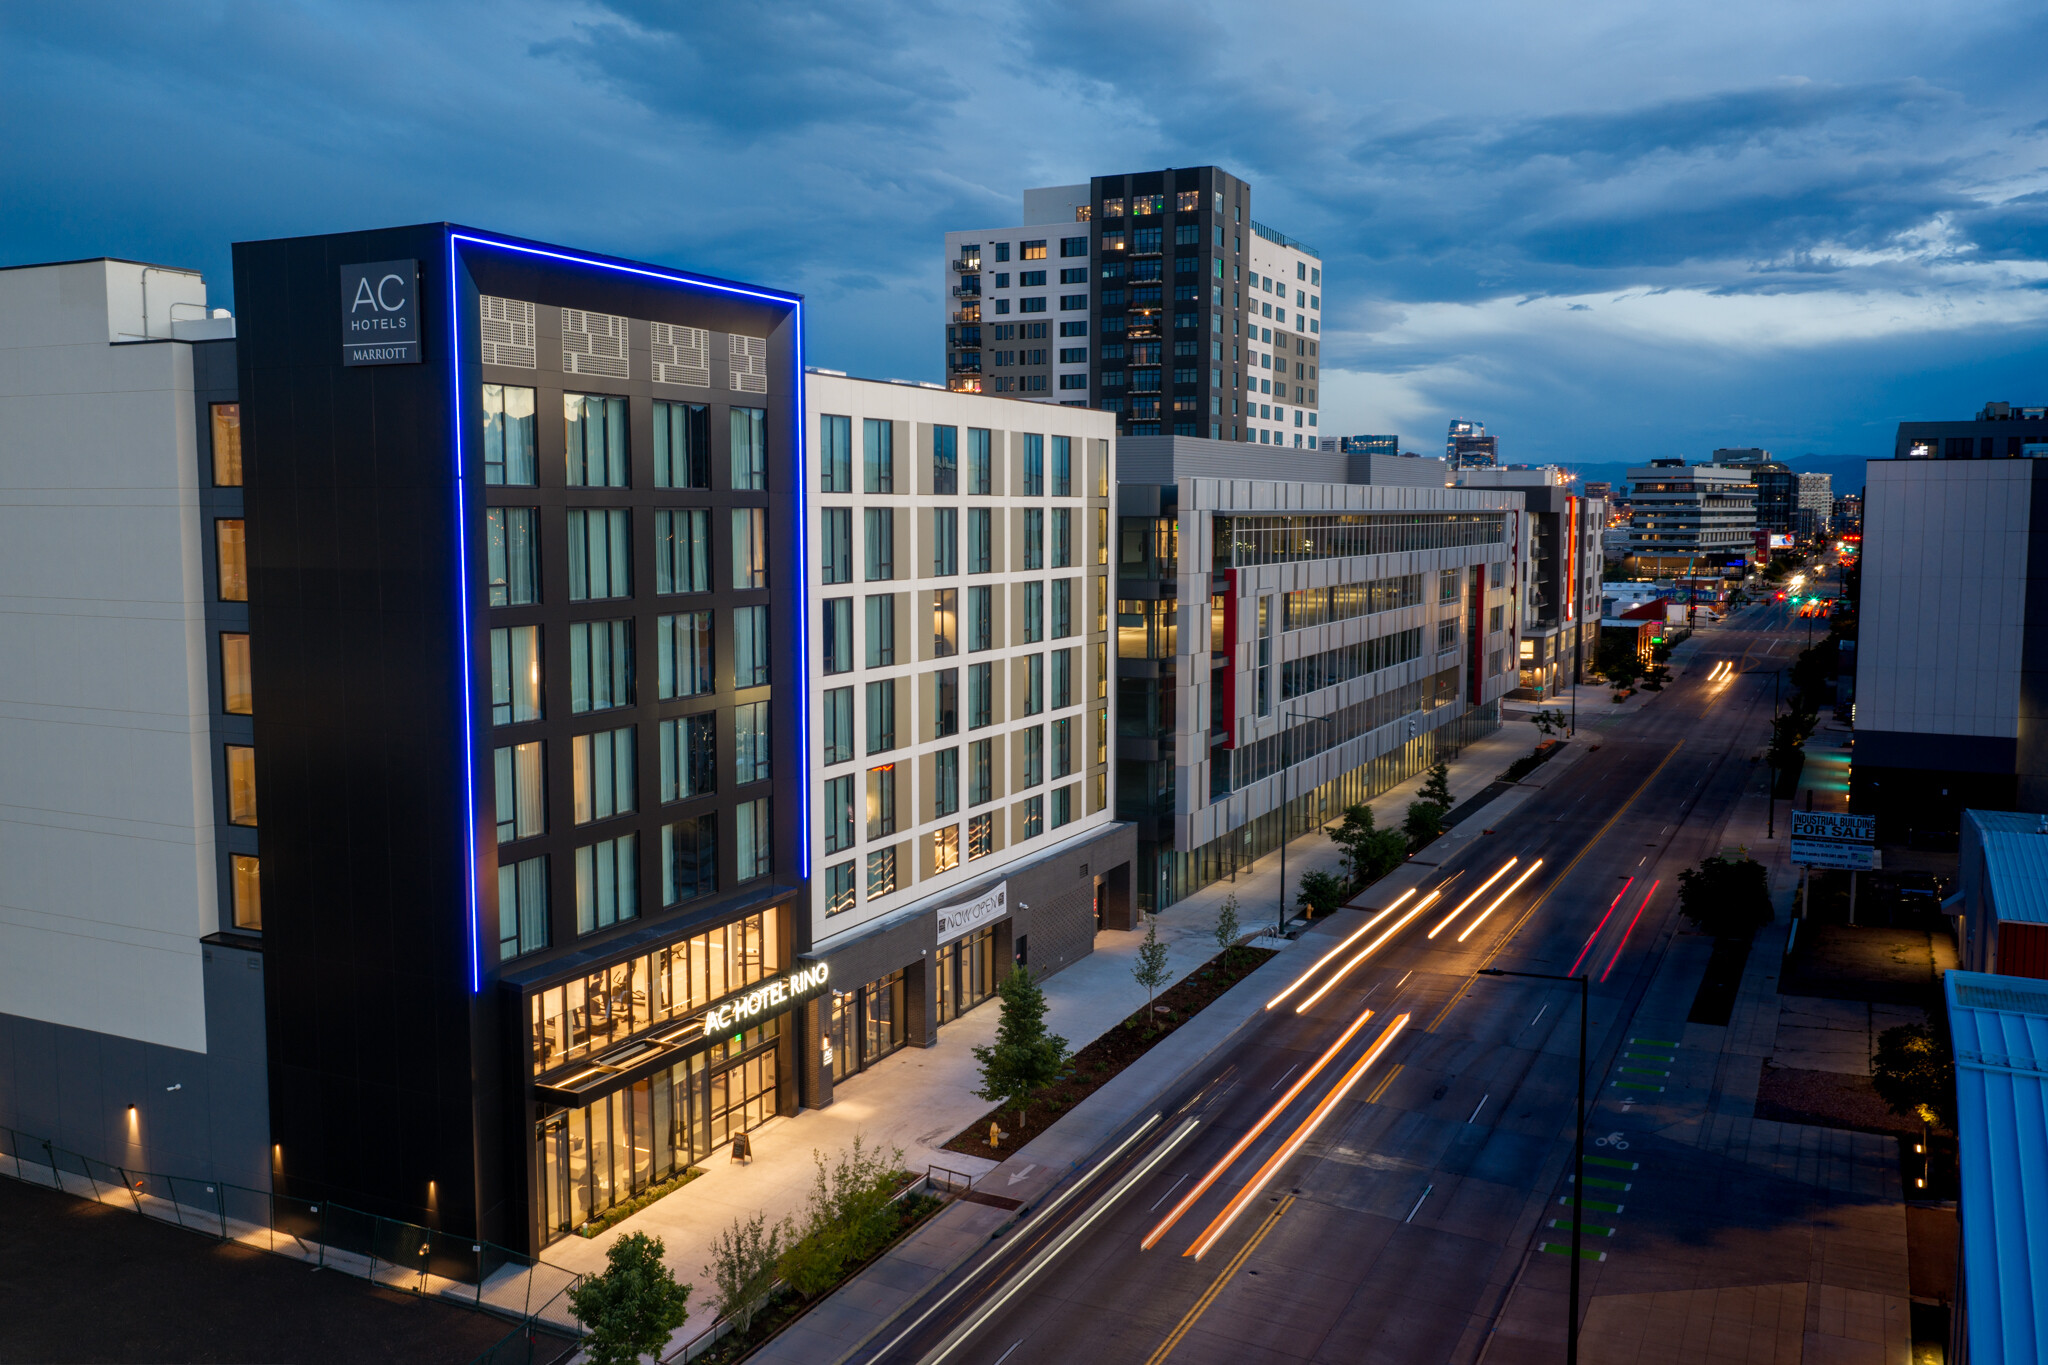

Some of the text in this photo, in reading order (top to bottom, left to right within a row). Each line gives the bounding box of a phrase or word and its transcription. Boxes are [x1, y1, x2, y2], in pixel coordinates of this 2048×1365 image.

[351, 274, 406, 313] AC
[351, 317, 407, 331] HOTELS
[353, 347, 407, 361] MARRIOTT
[1794, 814, 1875, 828] INDUSTRIAL BUILDING
[1794, 824, 1875, 838] FOR SALE
[946, 908, 973, 929] NOW
[972, 894, 998, 919] OPEN
[703, 962, 829, 1036] AC HOTEL RINO
